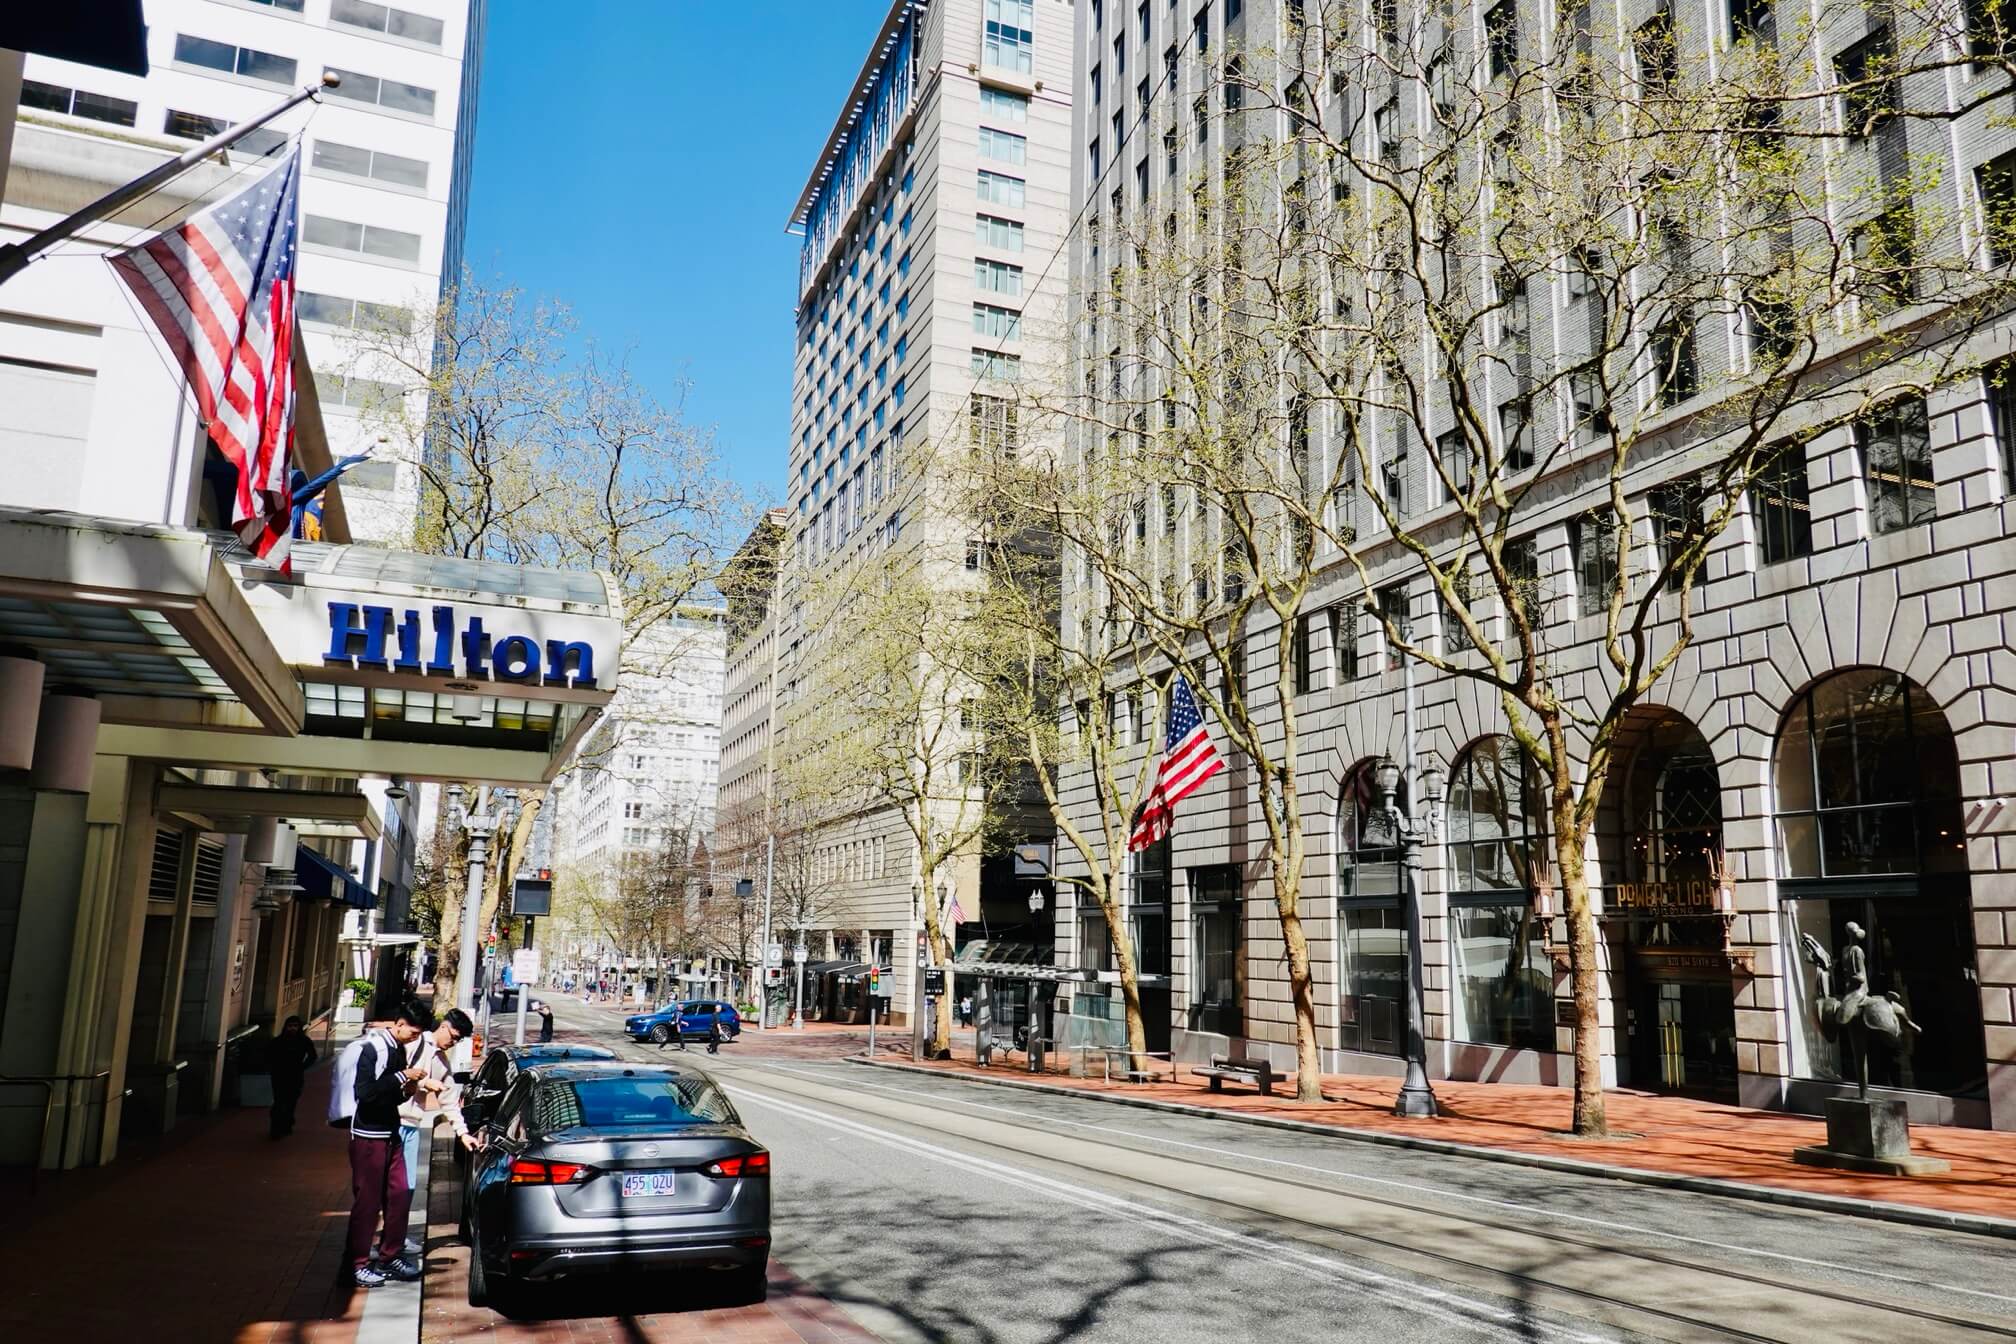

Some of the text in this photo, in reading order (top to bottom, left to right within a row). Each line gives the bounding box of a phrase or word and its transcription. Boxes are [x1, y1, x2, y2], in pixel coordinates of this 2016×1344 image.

[322, 601, 598, 683] Hilton
[1616, 883, 1663, 908] POWER
[1676, 881, 1714, 906] LIGH
[625, 1176, 646, 1190] 455
